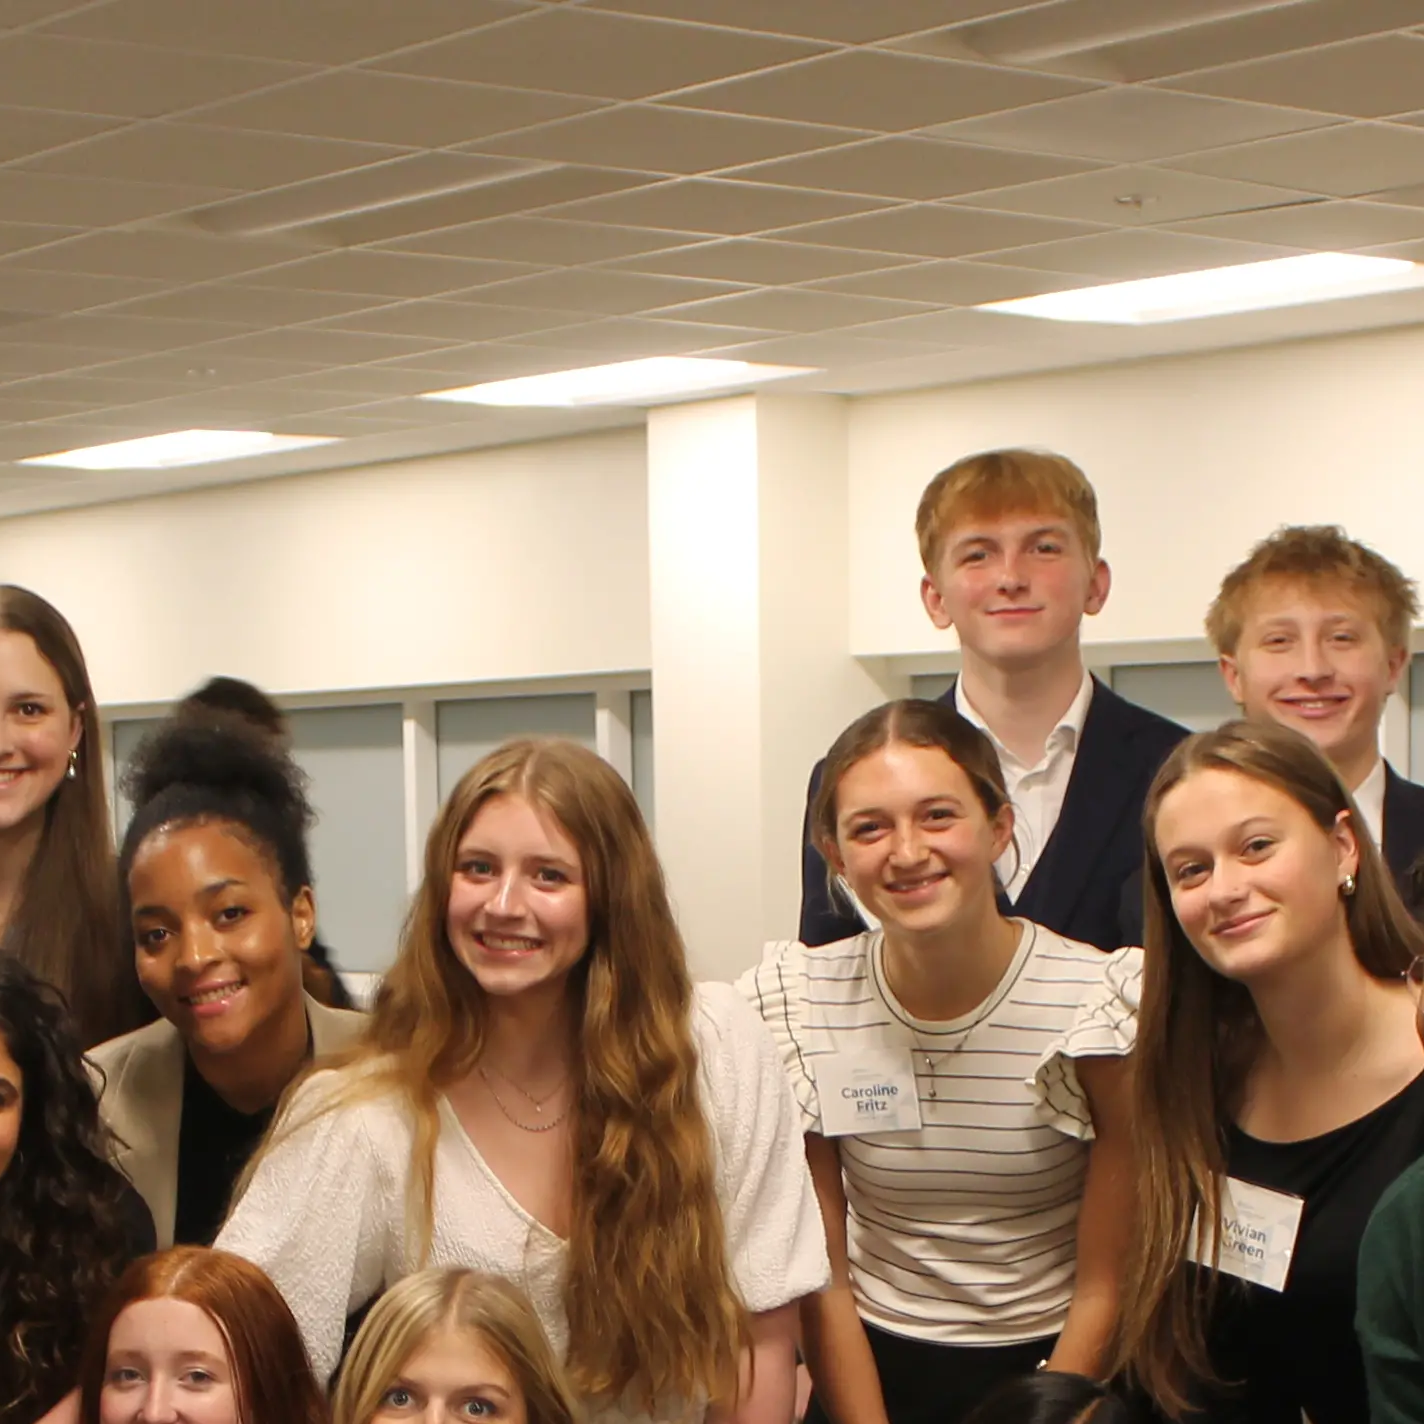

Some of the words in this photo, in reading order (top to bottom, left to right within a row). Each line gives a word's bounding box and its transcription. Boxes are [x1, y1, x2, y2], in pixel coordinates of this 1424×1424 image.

[841, 1084, 899, 1100] Caroline
[856, 1098, 888, 1112] Fritz
[1222, 1217, 1267, 1244] Vivian
